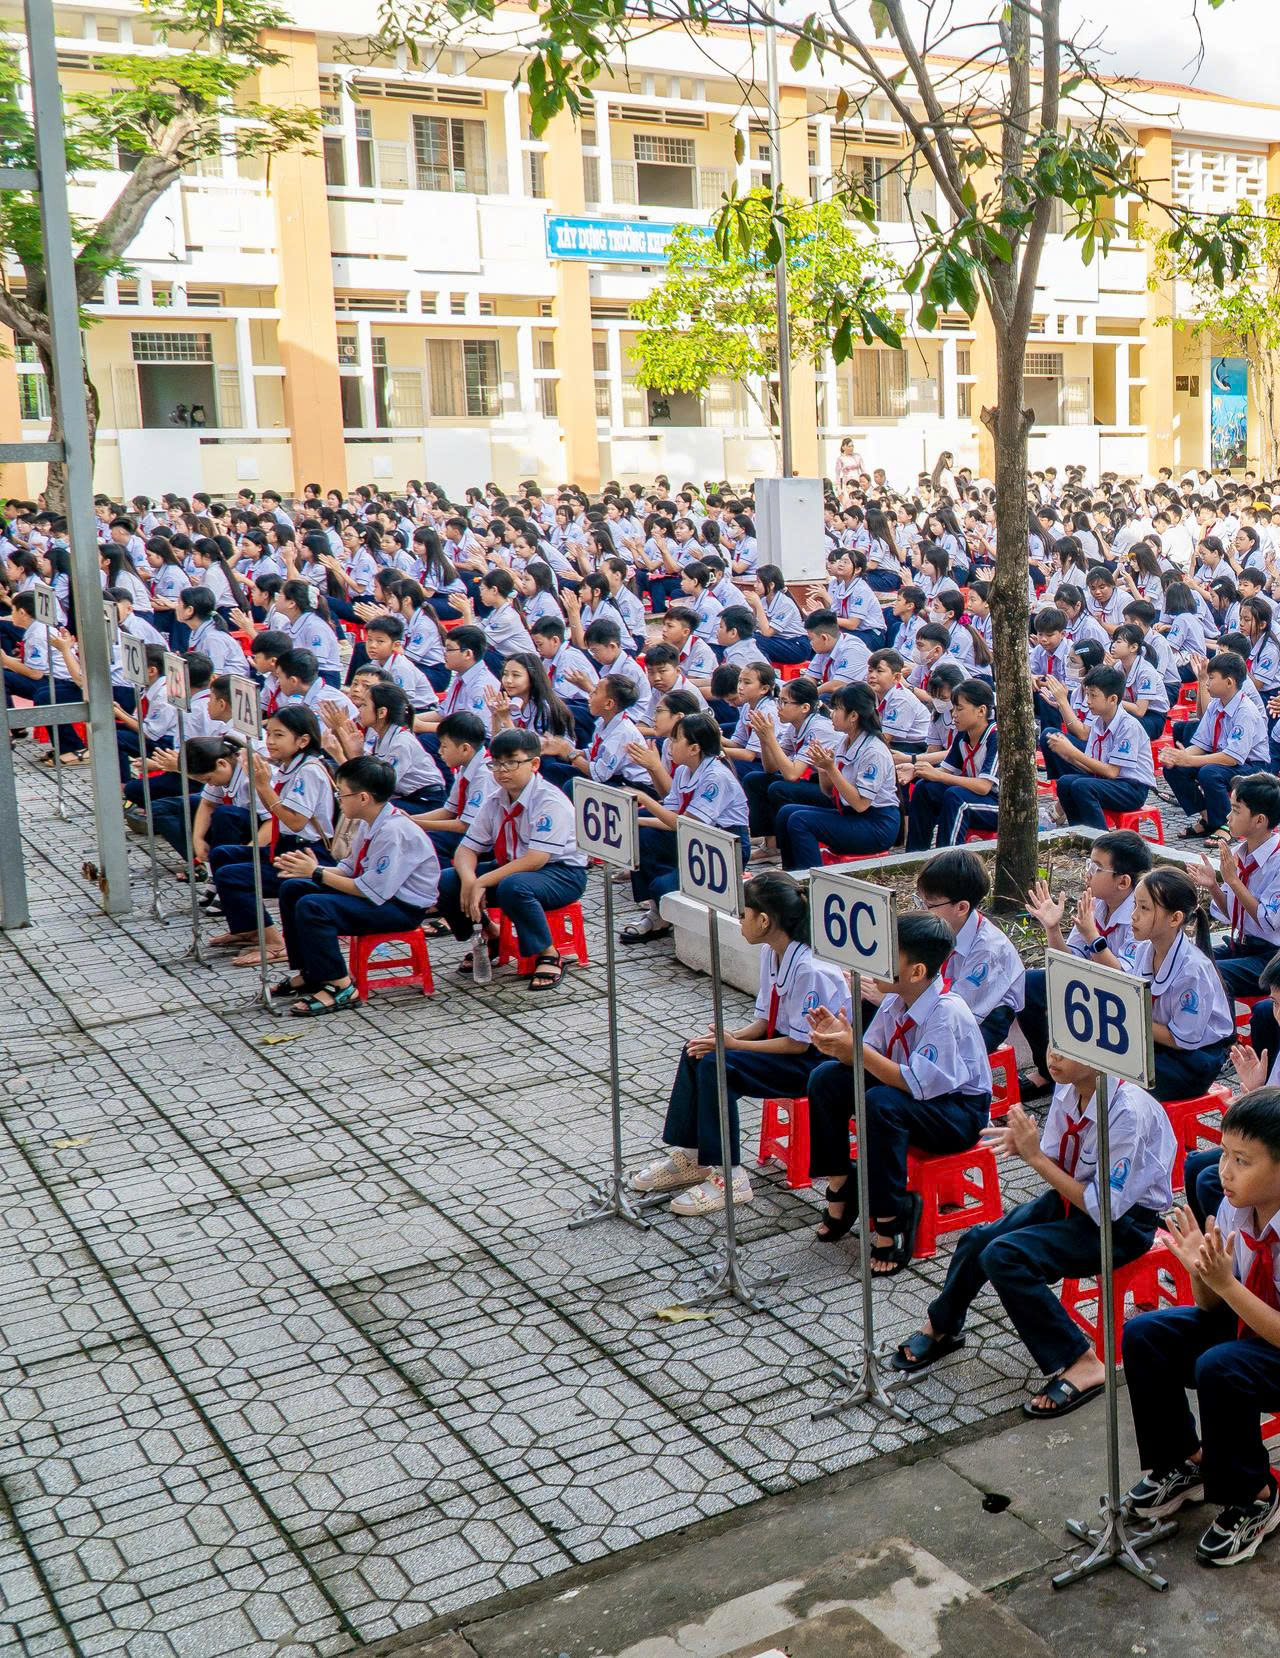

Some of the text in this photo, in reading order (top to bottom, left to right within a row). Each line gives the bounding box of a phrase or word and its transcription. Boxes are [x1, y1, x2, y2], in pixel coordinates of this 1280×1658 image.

[556, 222, 577, 249] XÂY
[124, 643, 140, 675] 7C
[234, 687, 255, 726] 7A
[583, 796, 623, 849] 6E
[688, 838, 728, 895] 6D
[823, 893, 879, 957] 6C
[1064, 979, 1130, 1056] 6B
